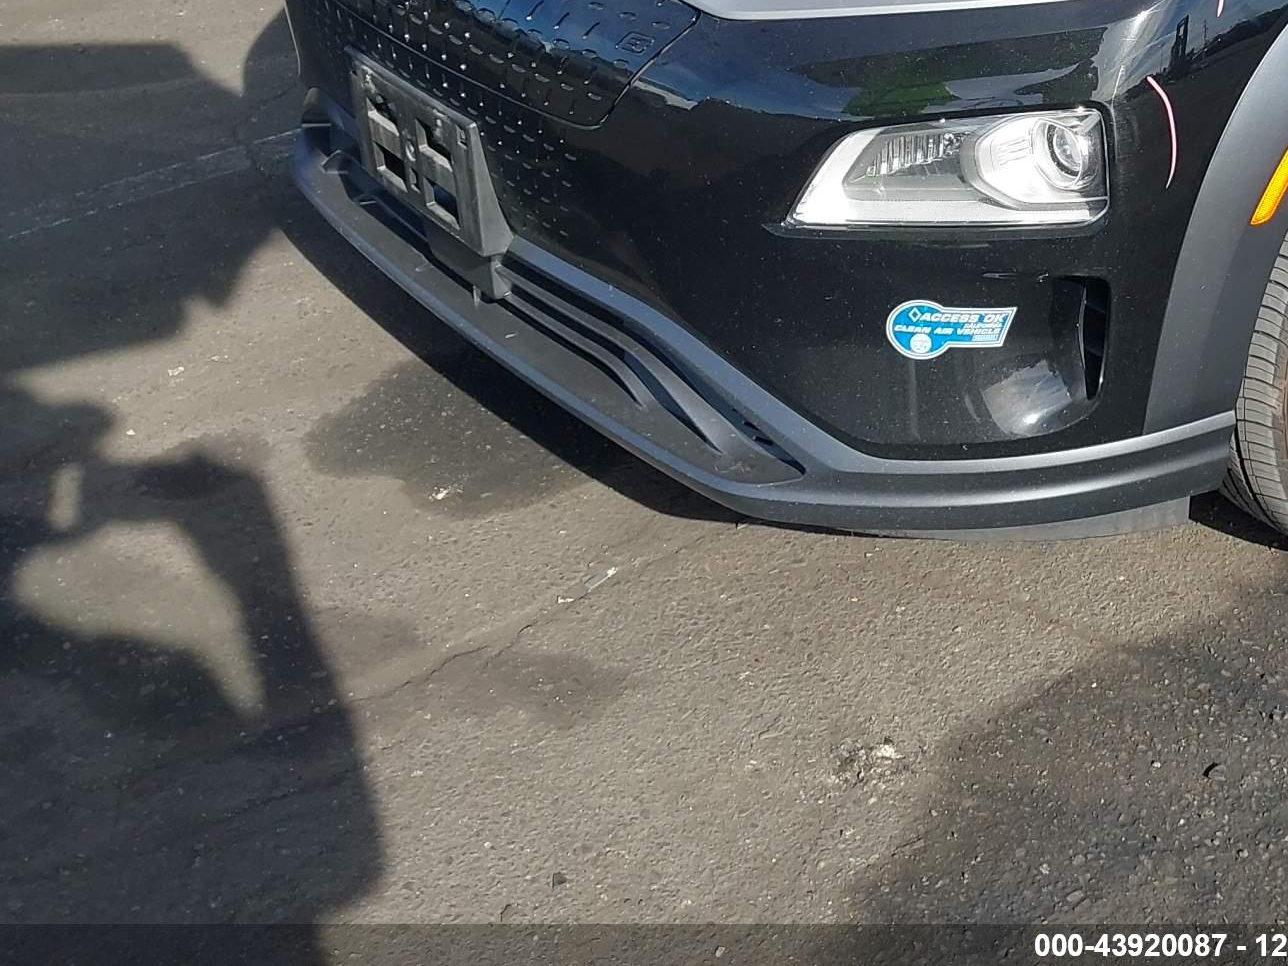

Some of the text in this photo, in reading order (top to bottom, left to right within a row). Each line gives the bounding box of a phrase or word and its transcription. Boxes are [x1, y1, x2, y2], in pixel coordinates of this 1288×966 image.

[919, 312, 1008, 323] ACCESS OK
[894, 325, 1001, 335] CLEAN AIR VEHICLE
